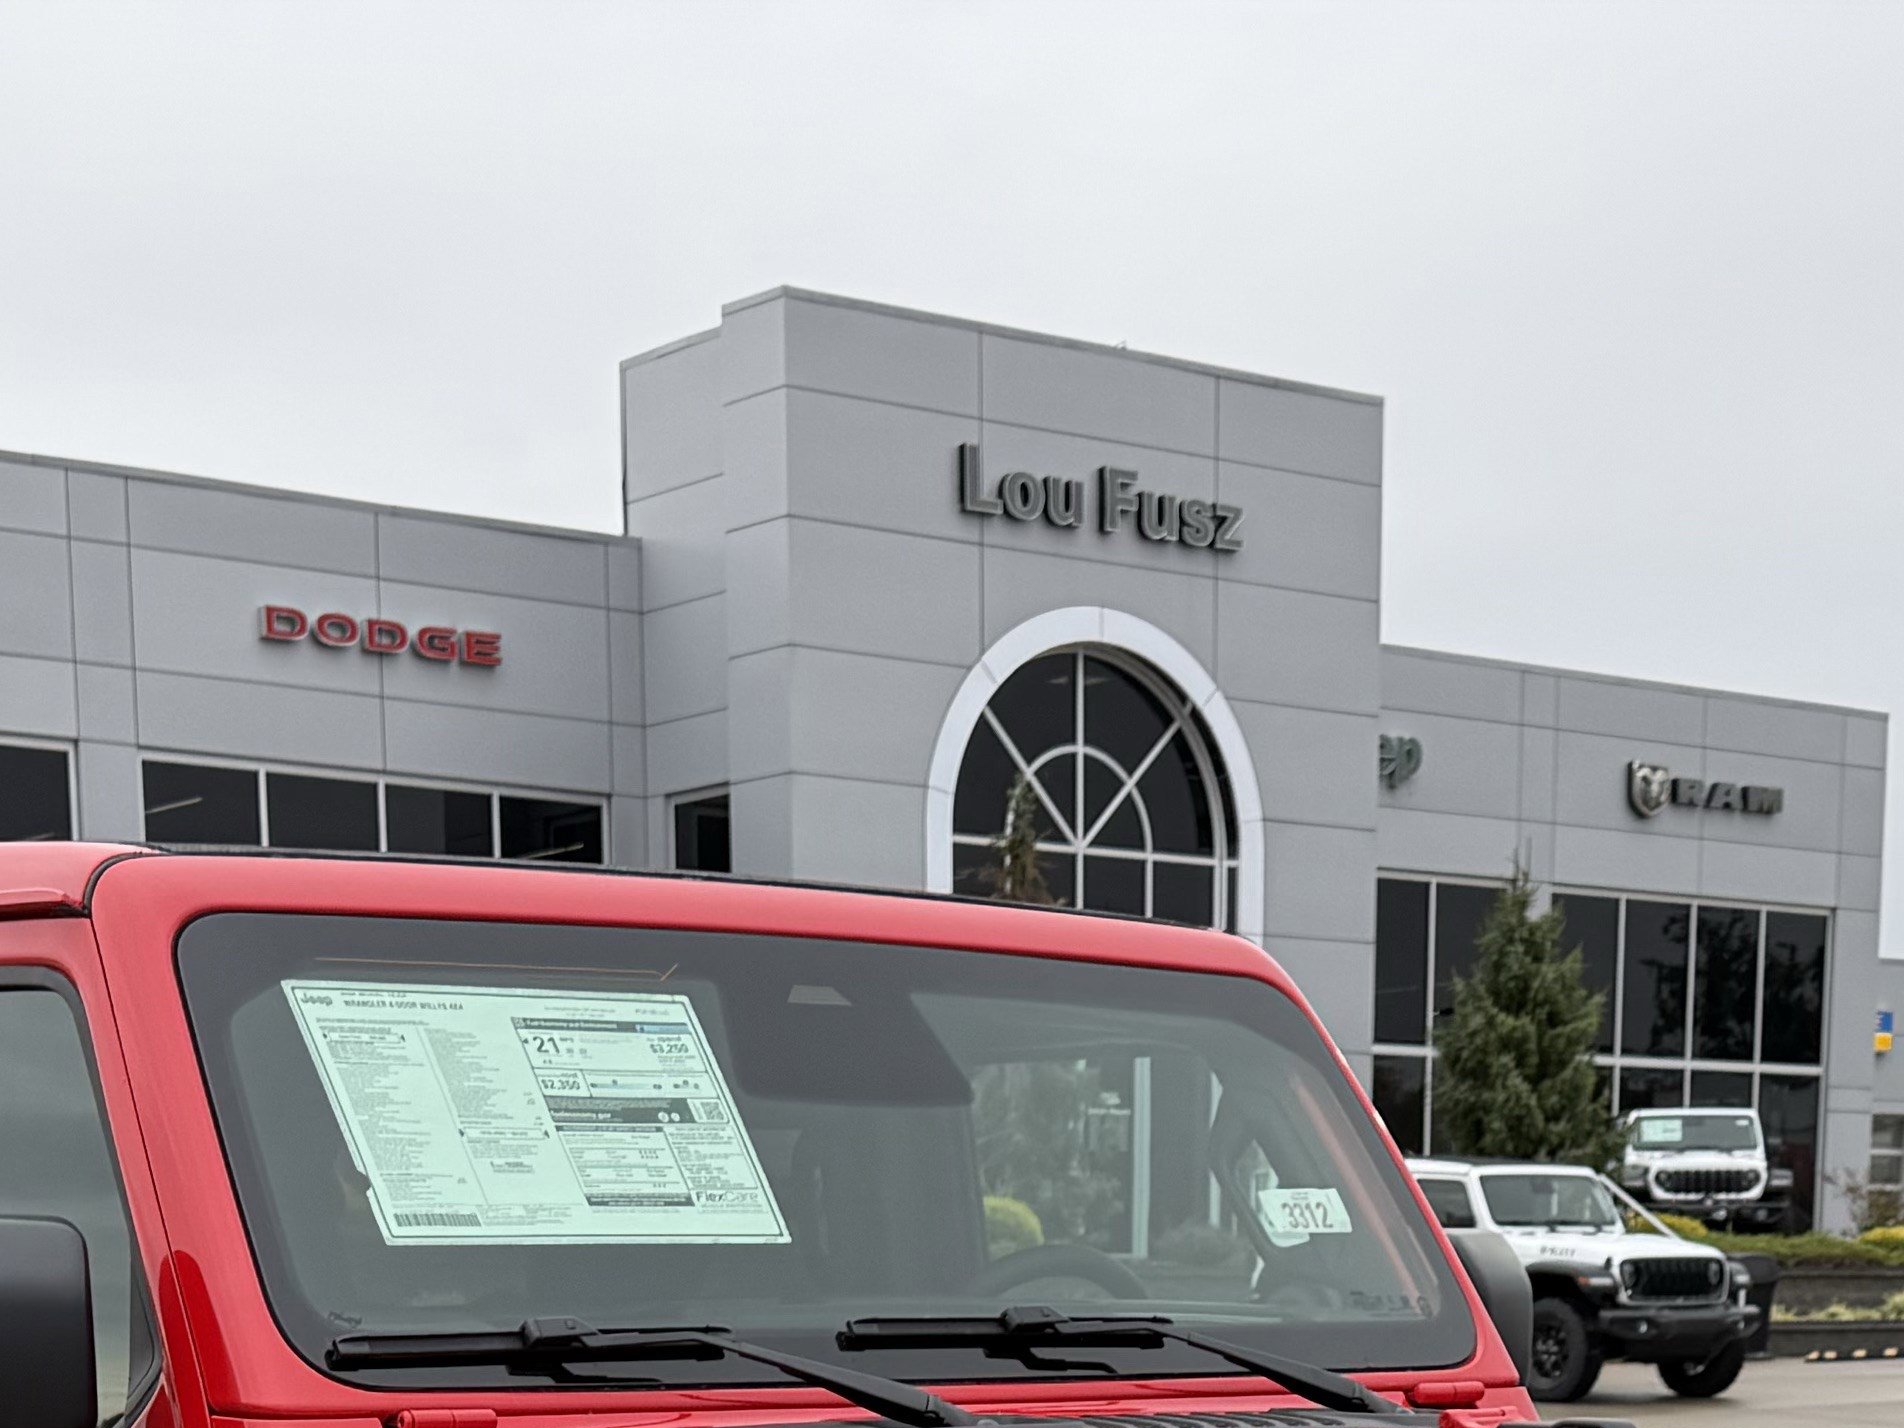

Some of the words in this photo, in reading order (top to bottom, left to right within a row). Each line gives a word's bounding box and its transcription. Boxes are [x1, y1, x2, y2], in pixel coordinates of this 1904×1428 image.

[958, 442, 1086, 527] Lou
[1097, 465, 1246, 551] Fusz
[258, 604, 503, 666] DODGE
[1670, 777, 1784, 815] RAM
[532, 1036, 560, 1054] 21
[1281, 1202, 1334, 1229] 3312
